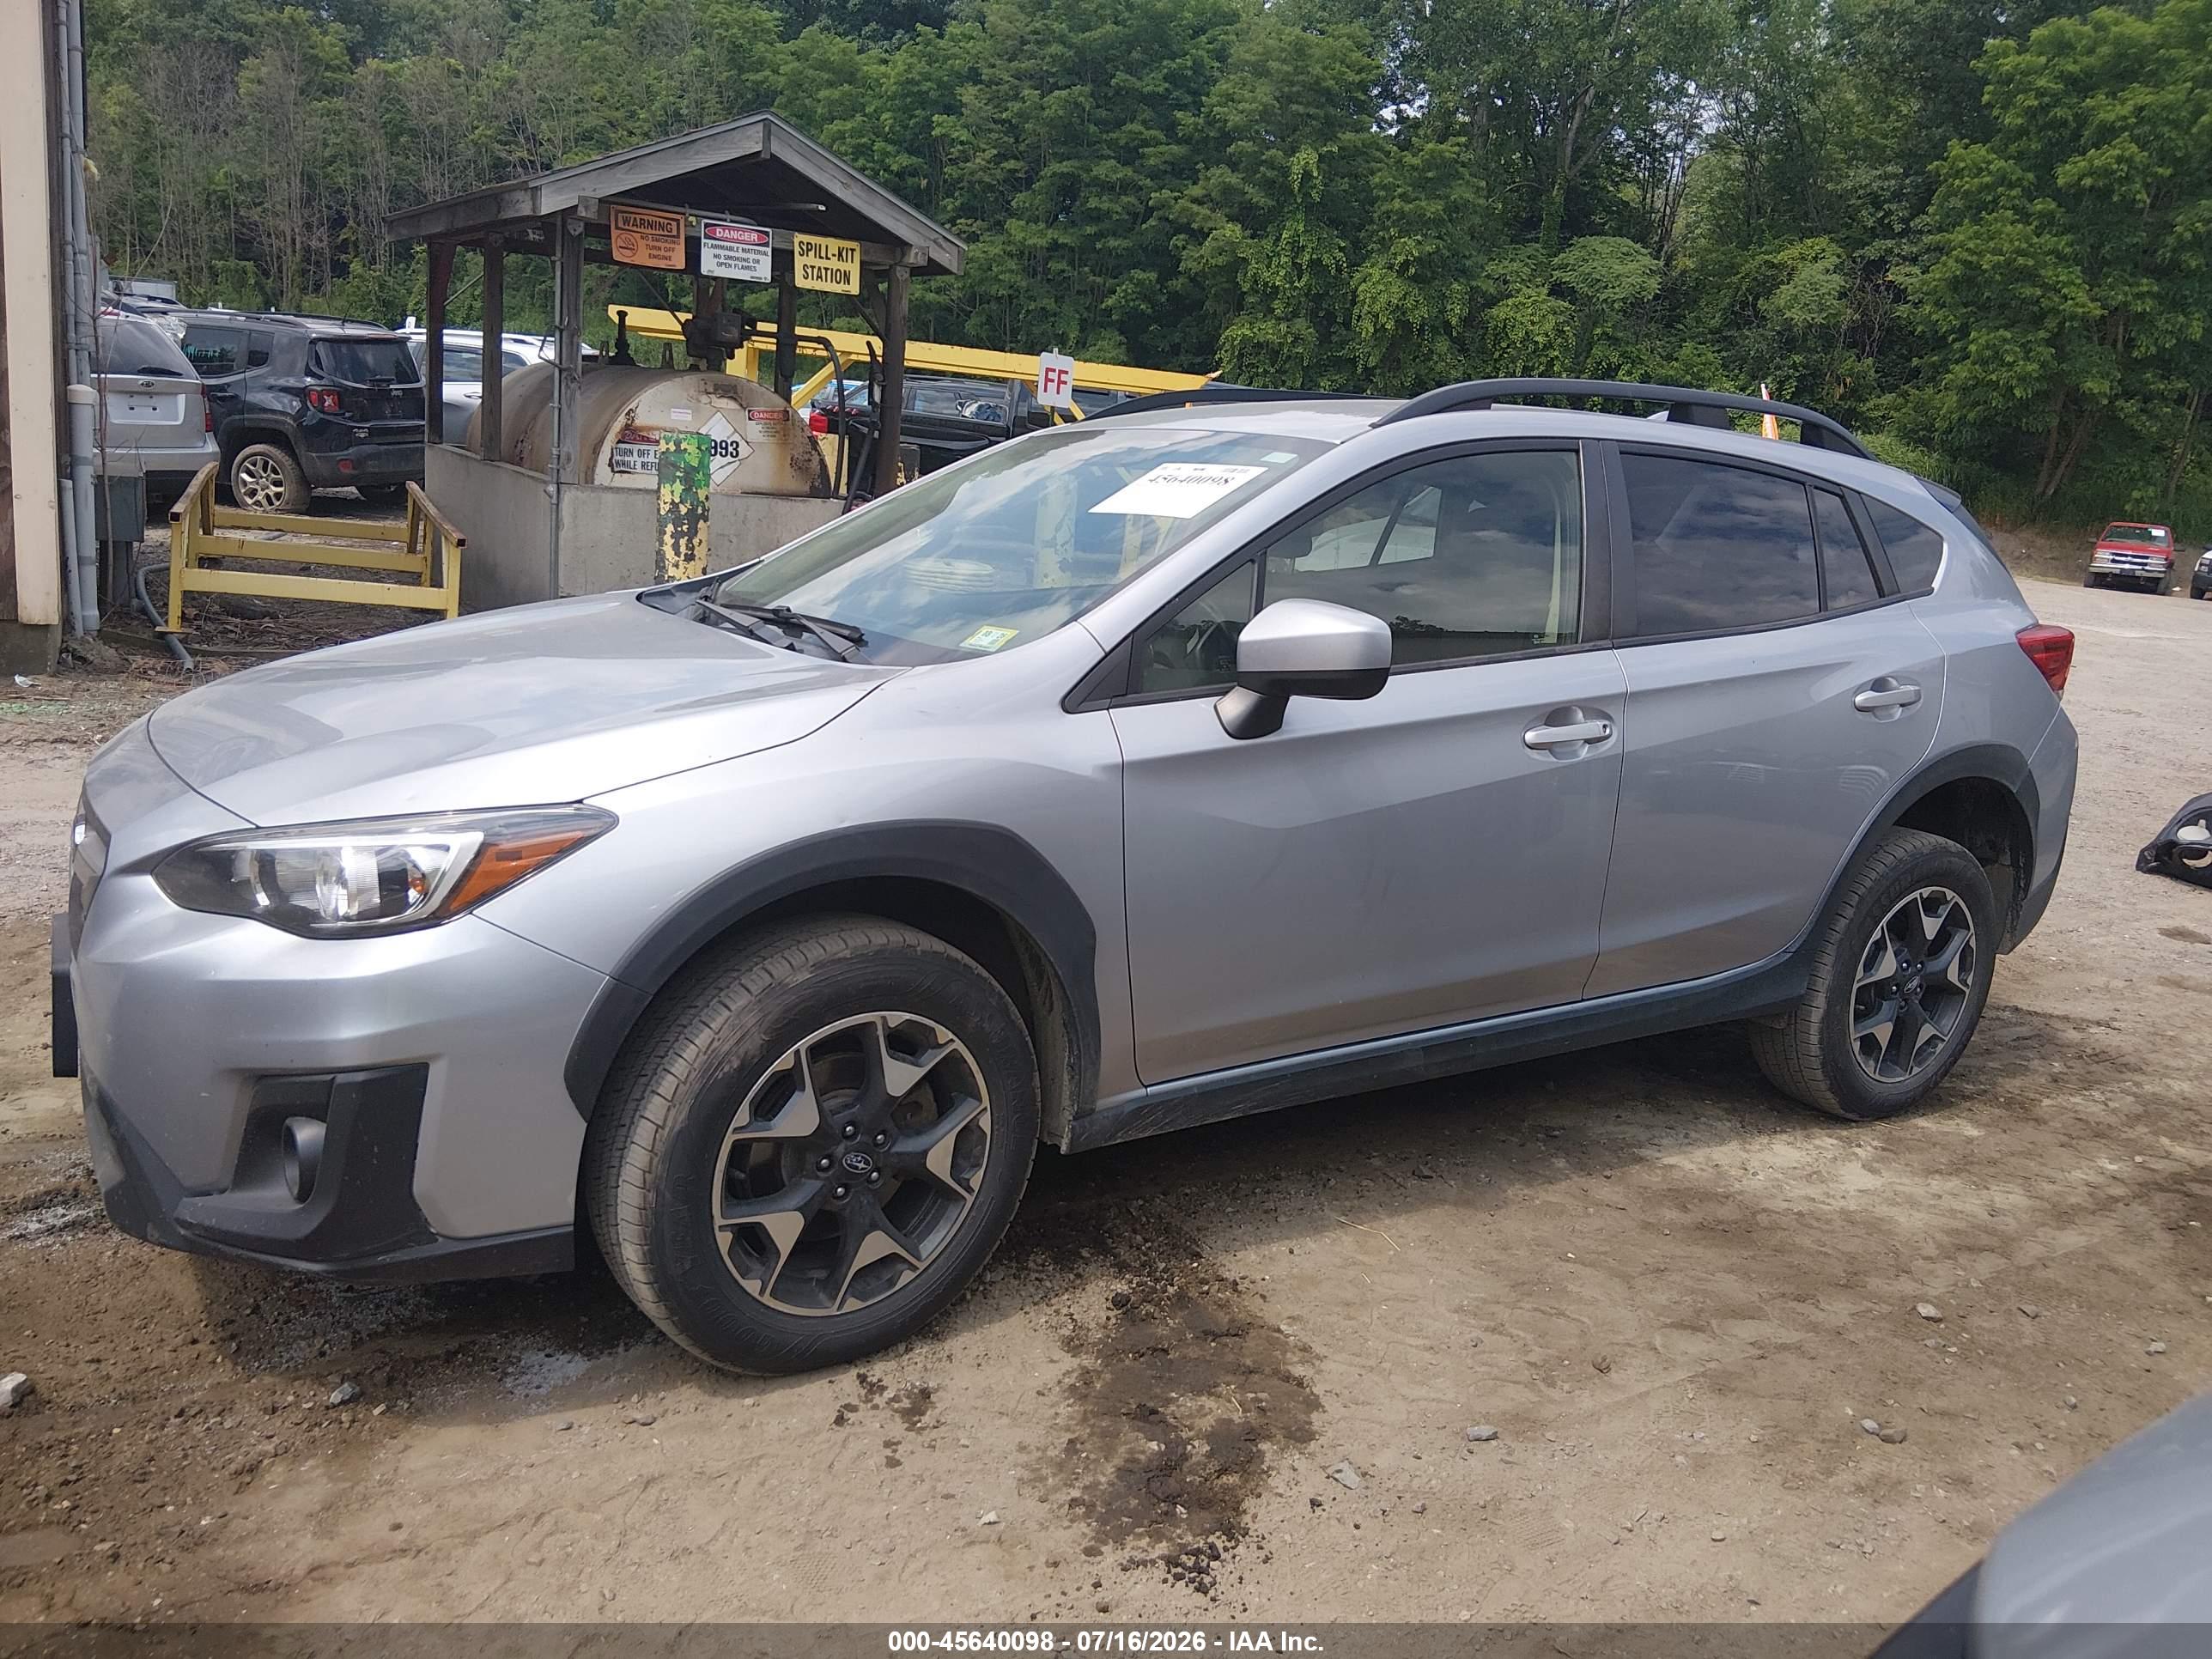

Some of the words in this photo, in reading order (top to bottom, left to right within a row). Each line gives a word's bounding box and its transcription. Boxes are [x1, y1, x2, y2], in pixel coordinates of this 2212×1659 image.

[622, 216, 673, 234] WARNING
[651, 236, 681, 246] SMOKING
[715, 228, 758, 242] DANGER
[646, 244, 662, 252] TURN
[702, 242, 740, 253] FLAMMABLE
[741, 247, 770, 257] MATERIAL
[798, 240, 856, 264] SPILL-KIT
[723, 254, 751, 264] SMOKING
[733, 263, 757, 272] FLAMES
[802, 264, 851, 286] STATION
[1043, 367, 1069, 395] FF
[615, 447, 634, 458] TURN
[637, 448, 651, 459] OFF
[709, 439, 739, 459] 993
[614, 459, 638, 471] WHILE
[641, 460, 659, 471] REFU
